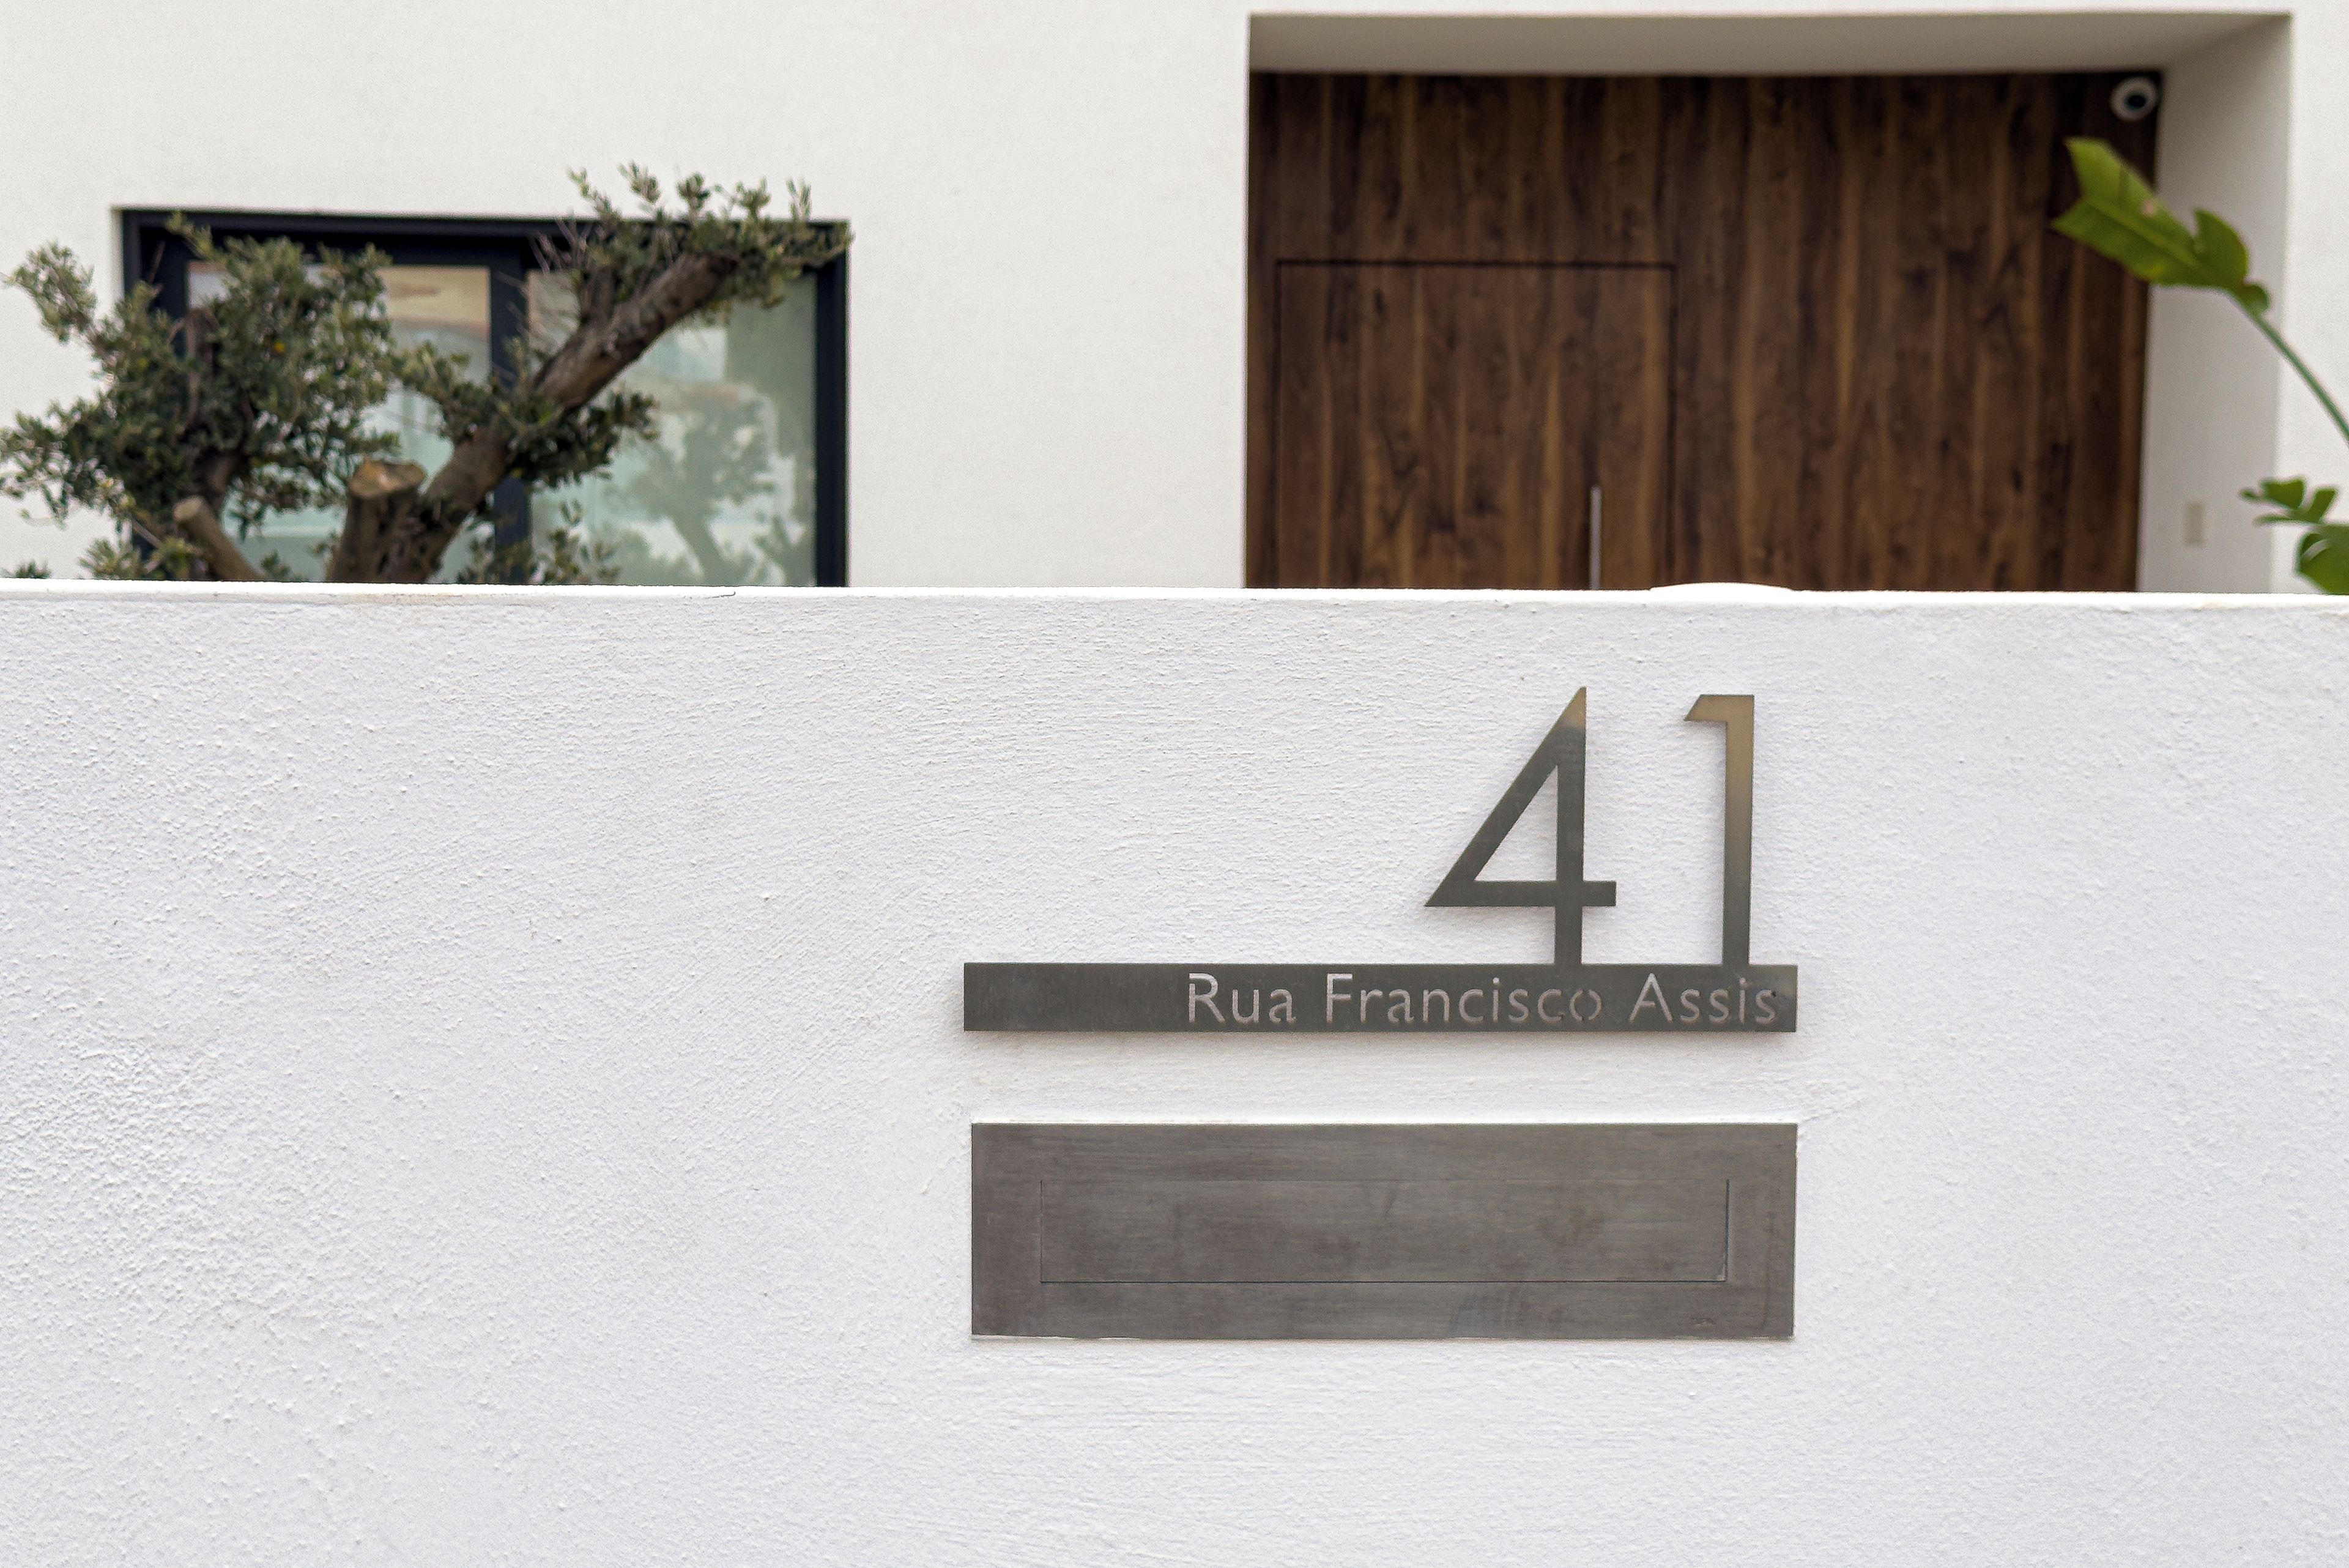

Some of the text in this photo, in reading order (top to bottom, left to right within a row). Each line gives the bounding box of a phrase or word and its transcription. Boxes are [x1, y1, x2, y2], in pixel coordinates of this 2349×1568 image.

[1424, 686, 1754, 965] 41
[1188, 972, 1777, 1025] Rua Francisco Assis
